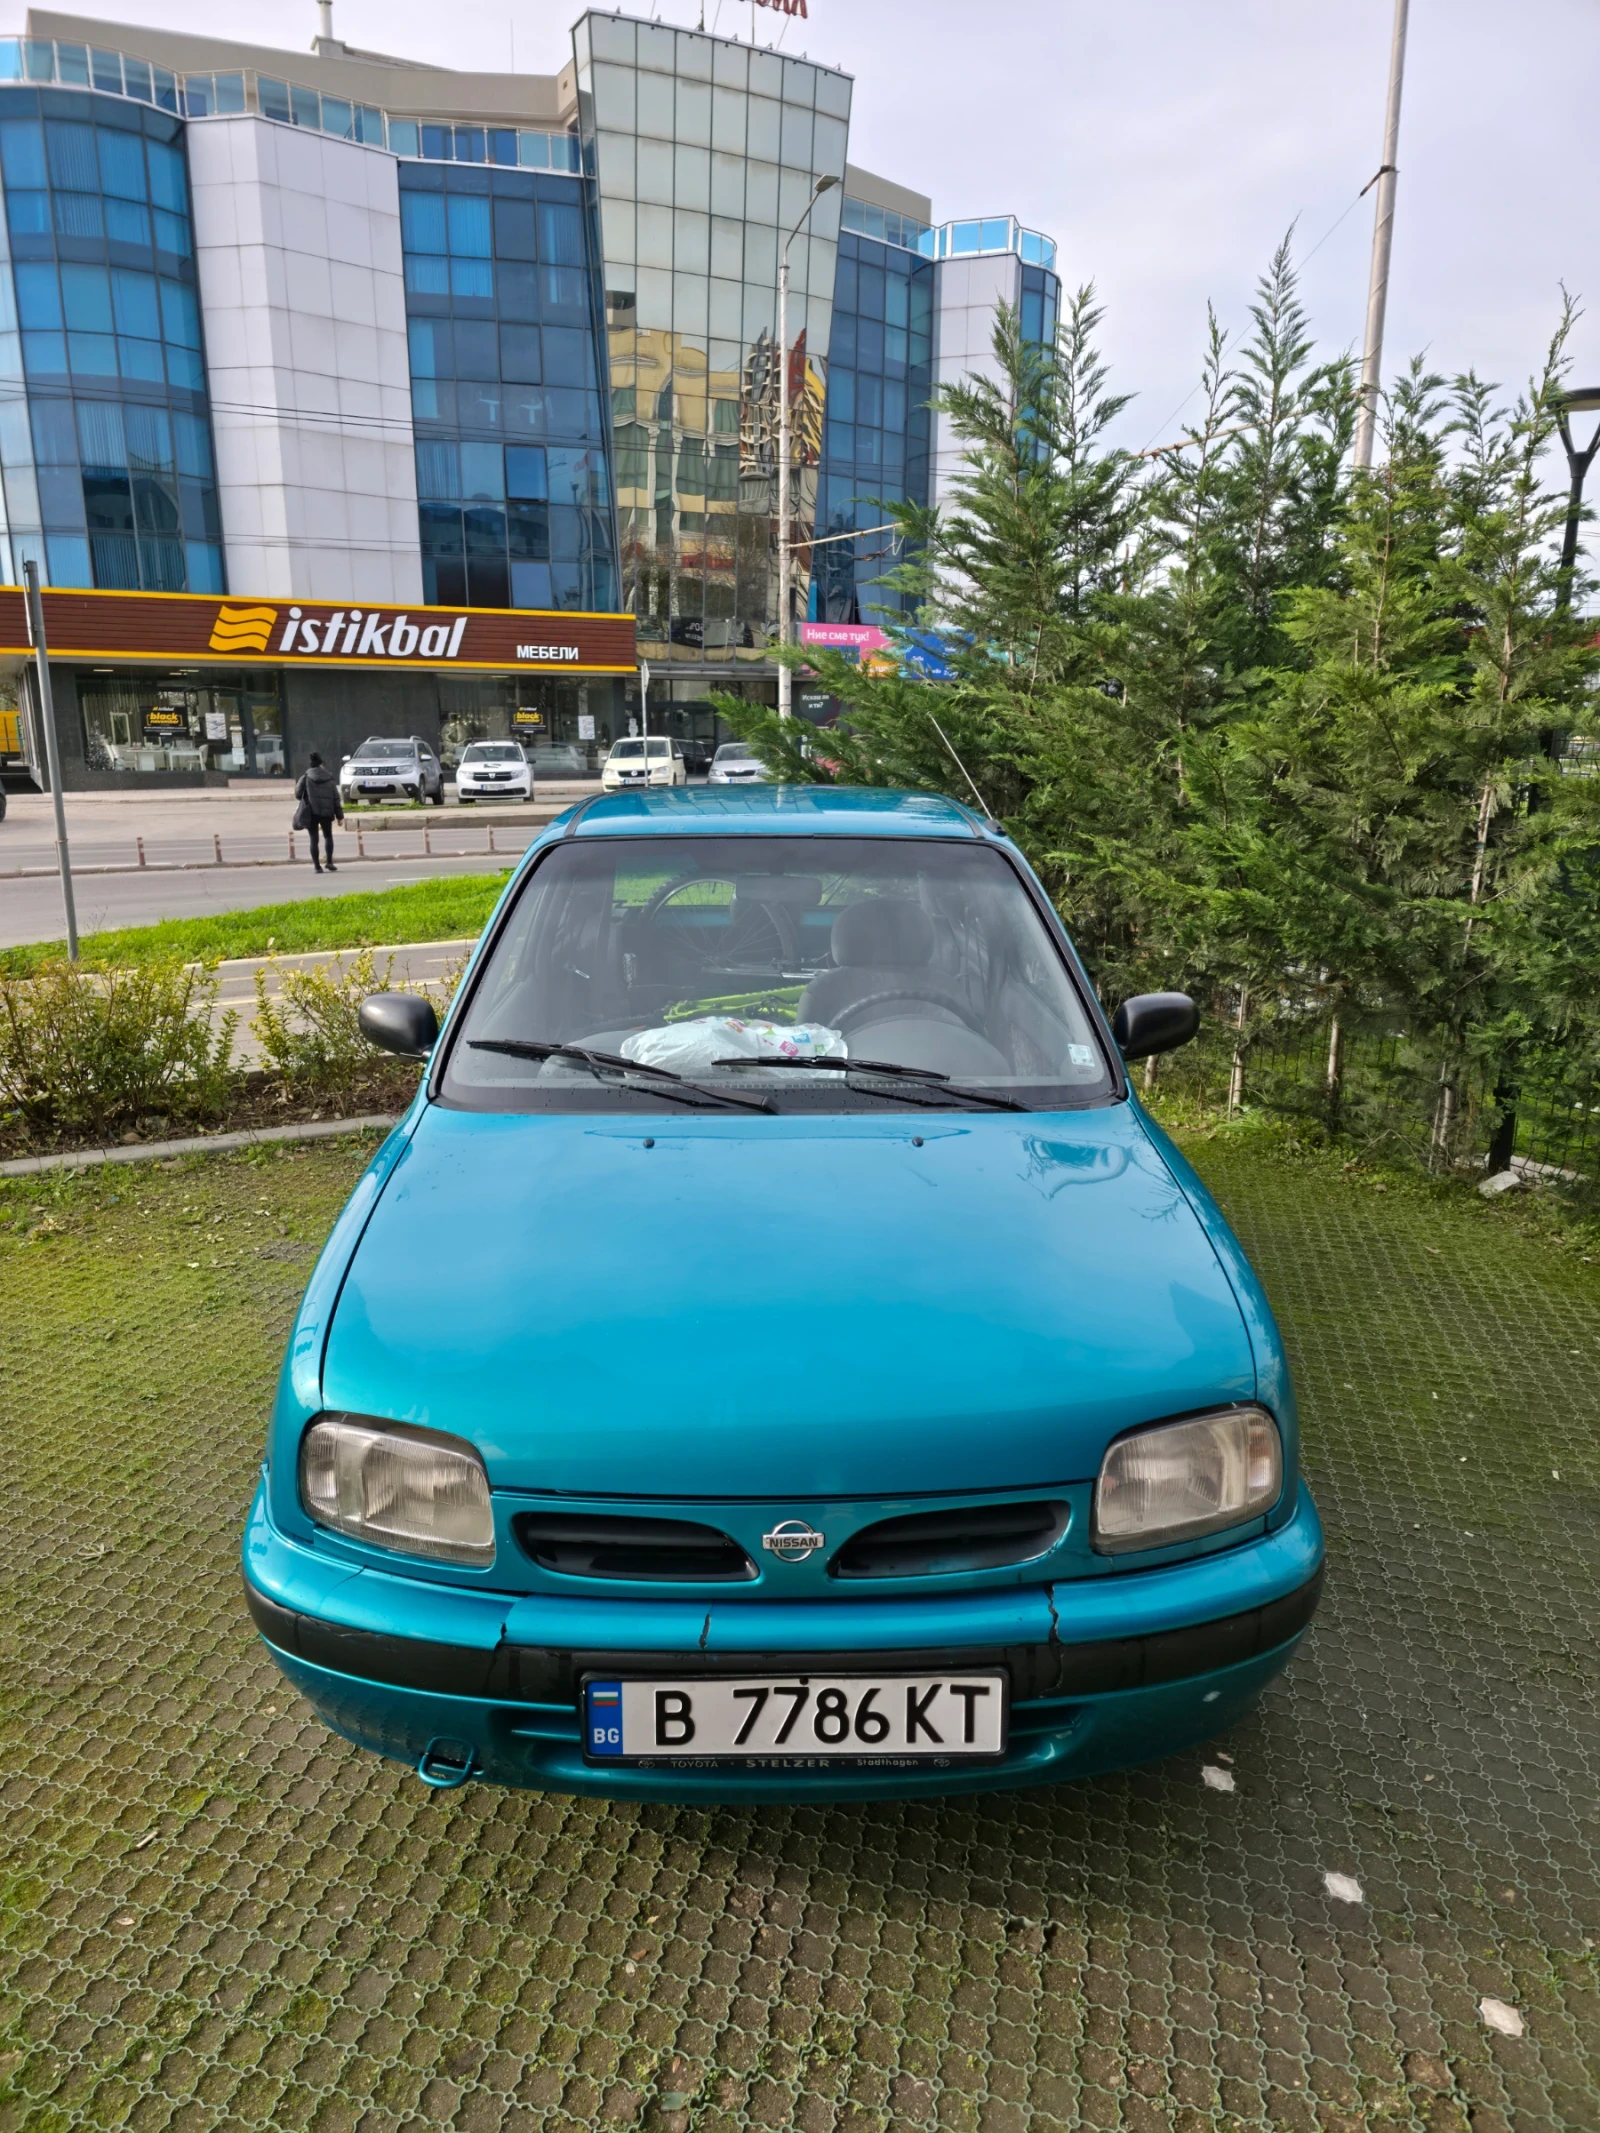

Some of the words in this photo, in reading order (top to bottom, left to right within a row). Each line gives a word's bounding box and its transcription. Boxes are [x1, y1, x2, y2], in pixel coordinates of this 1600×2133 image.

[279, 607, 467, 657] istikbal
[807, 629, 827, 640] Ние
[829, 631, 848, 641] сме
[849, 632, 869, 643] тук!
[516, 645, 579, 660] МЕБЕЛИ
[150, 712, 177, 720] black
[769, 1538, 818, 1547] NISSAN
[733, 1687, 890, 1744] 7786
[593, 1728, 620, 1744] BG
[670, 1760, 718, 1768] TOYOTA
[746, 1759, 830, 1768] STELZER
[857, 1758, 919, 1767] Stadthagen
